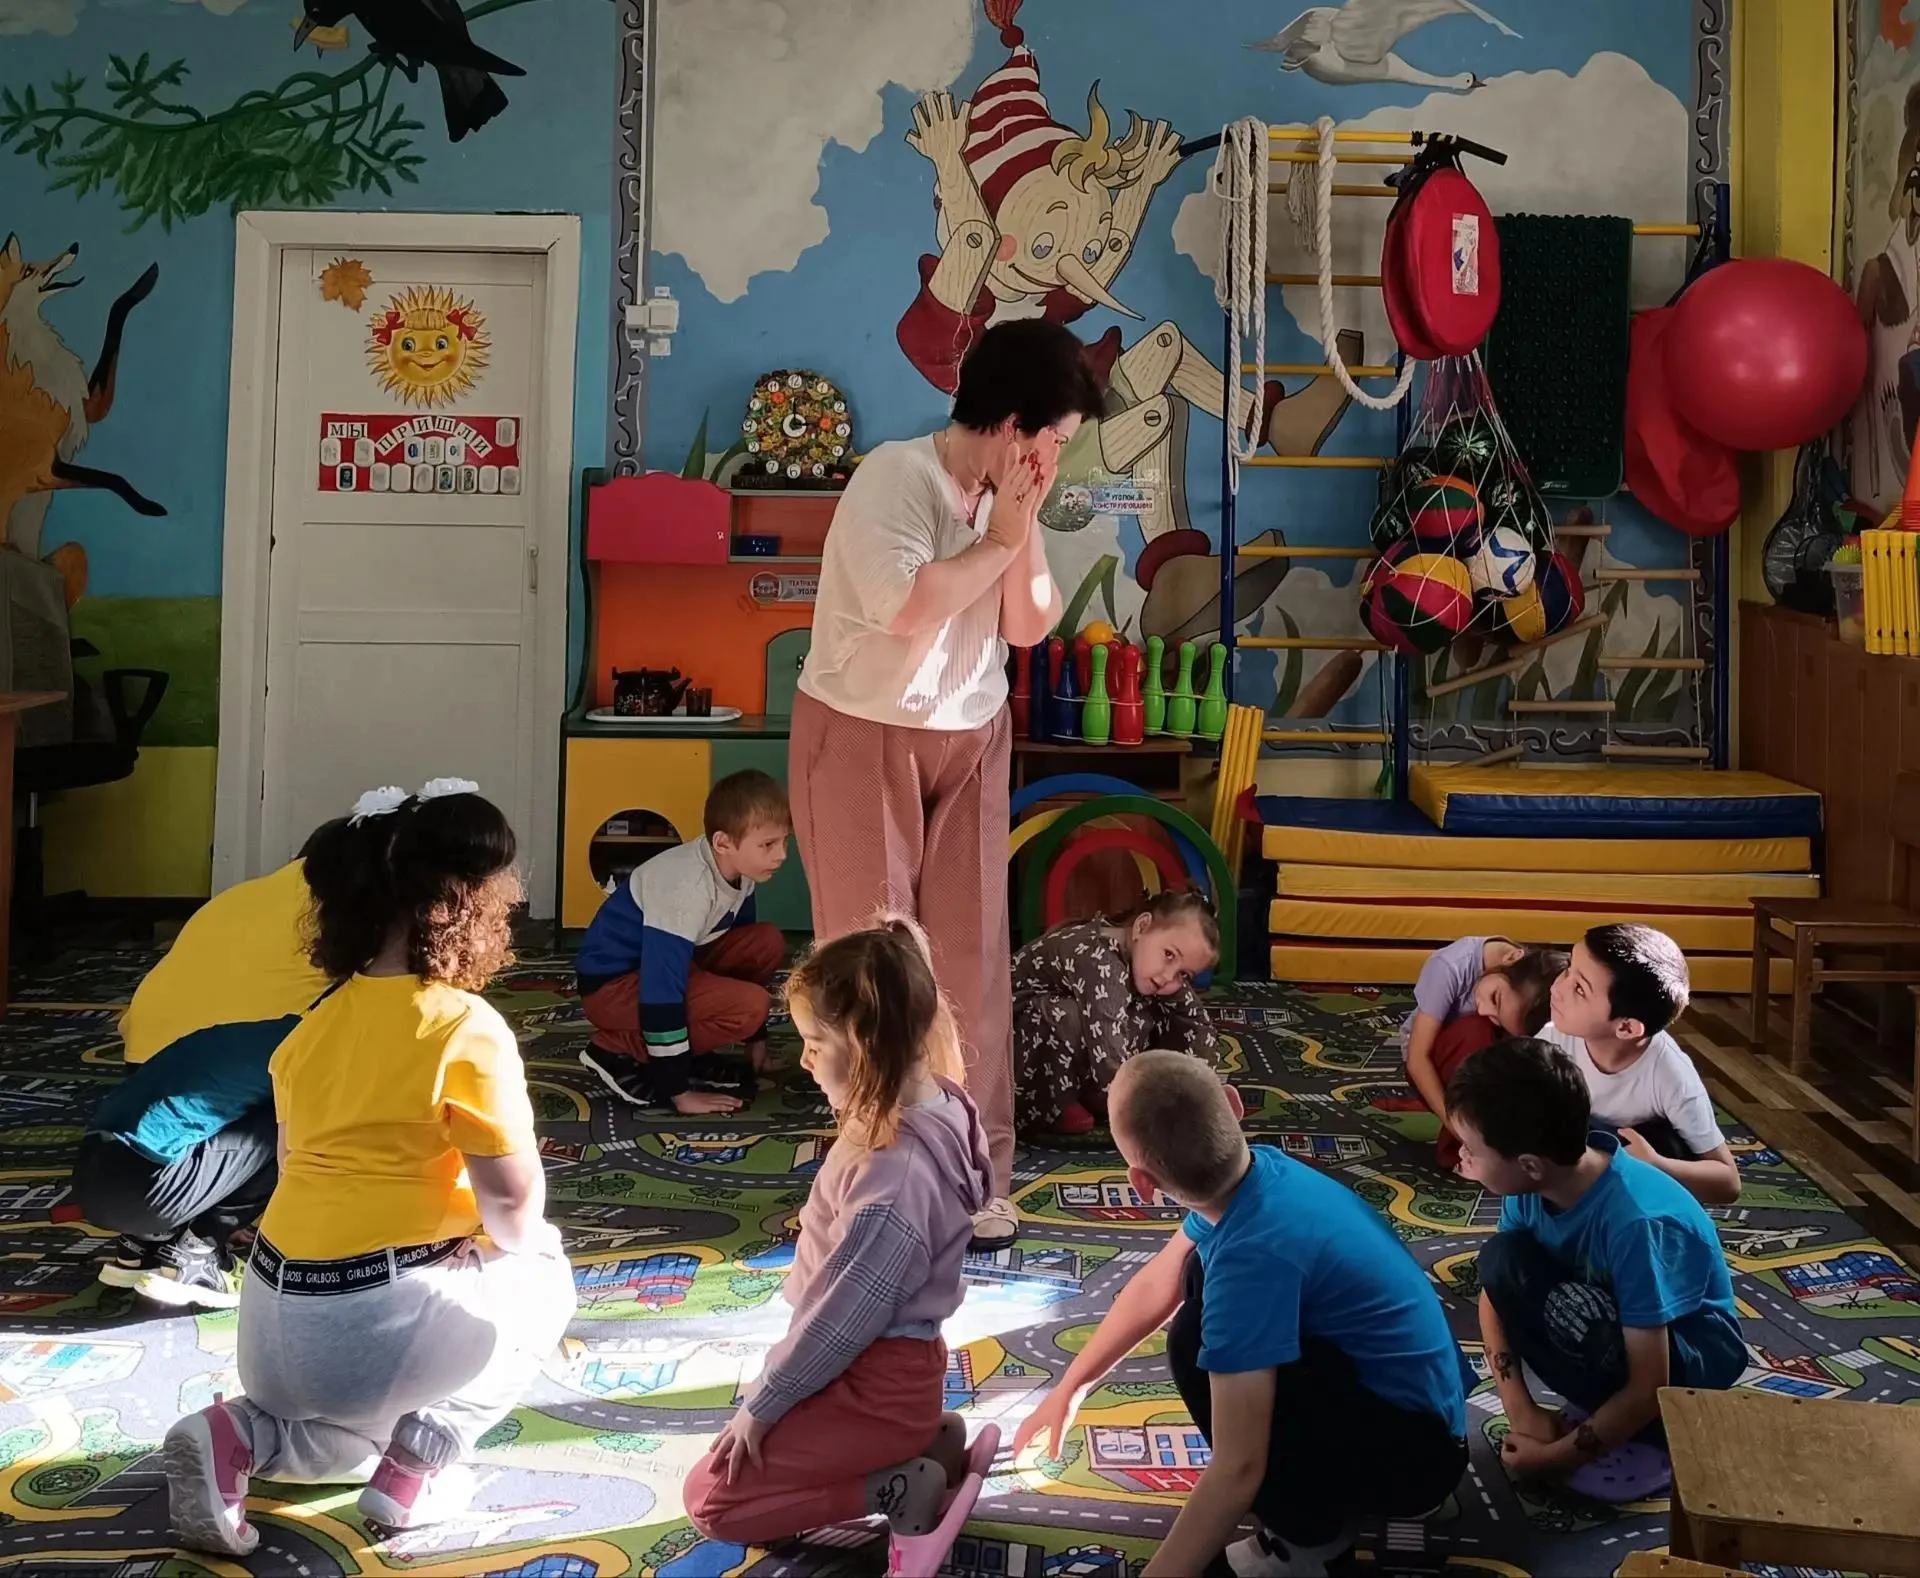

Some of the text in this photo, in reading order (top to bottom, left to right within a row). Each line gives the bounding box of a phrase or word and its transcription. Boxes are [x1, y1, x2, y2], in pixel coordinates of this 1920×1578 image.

[330, 423, 368, 439] МЫ
[379, 417, 489, 453] ПРИШЛИ
[306, 1272, 341, 1284] GIRLBOSS
[346, 1260, 388, 1281] GIRLBOSS
[395, 1246, 429, 1267] GIRLBOSS
